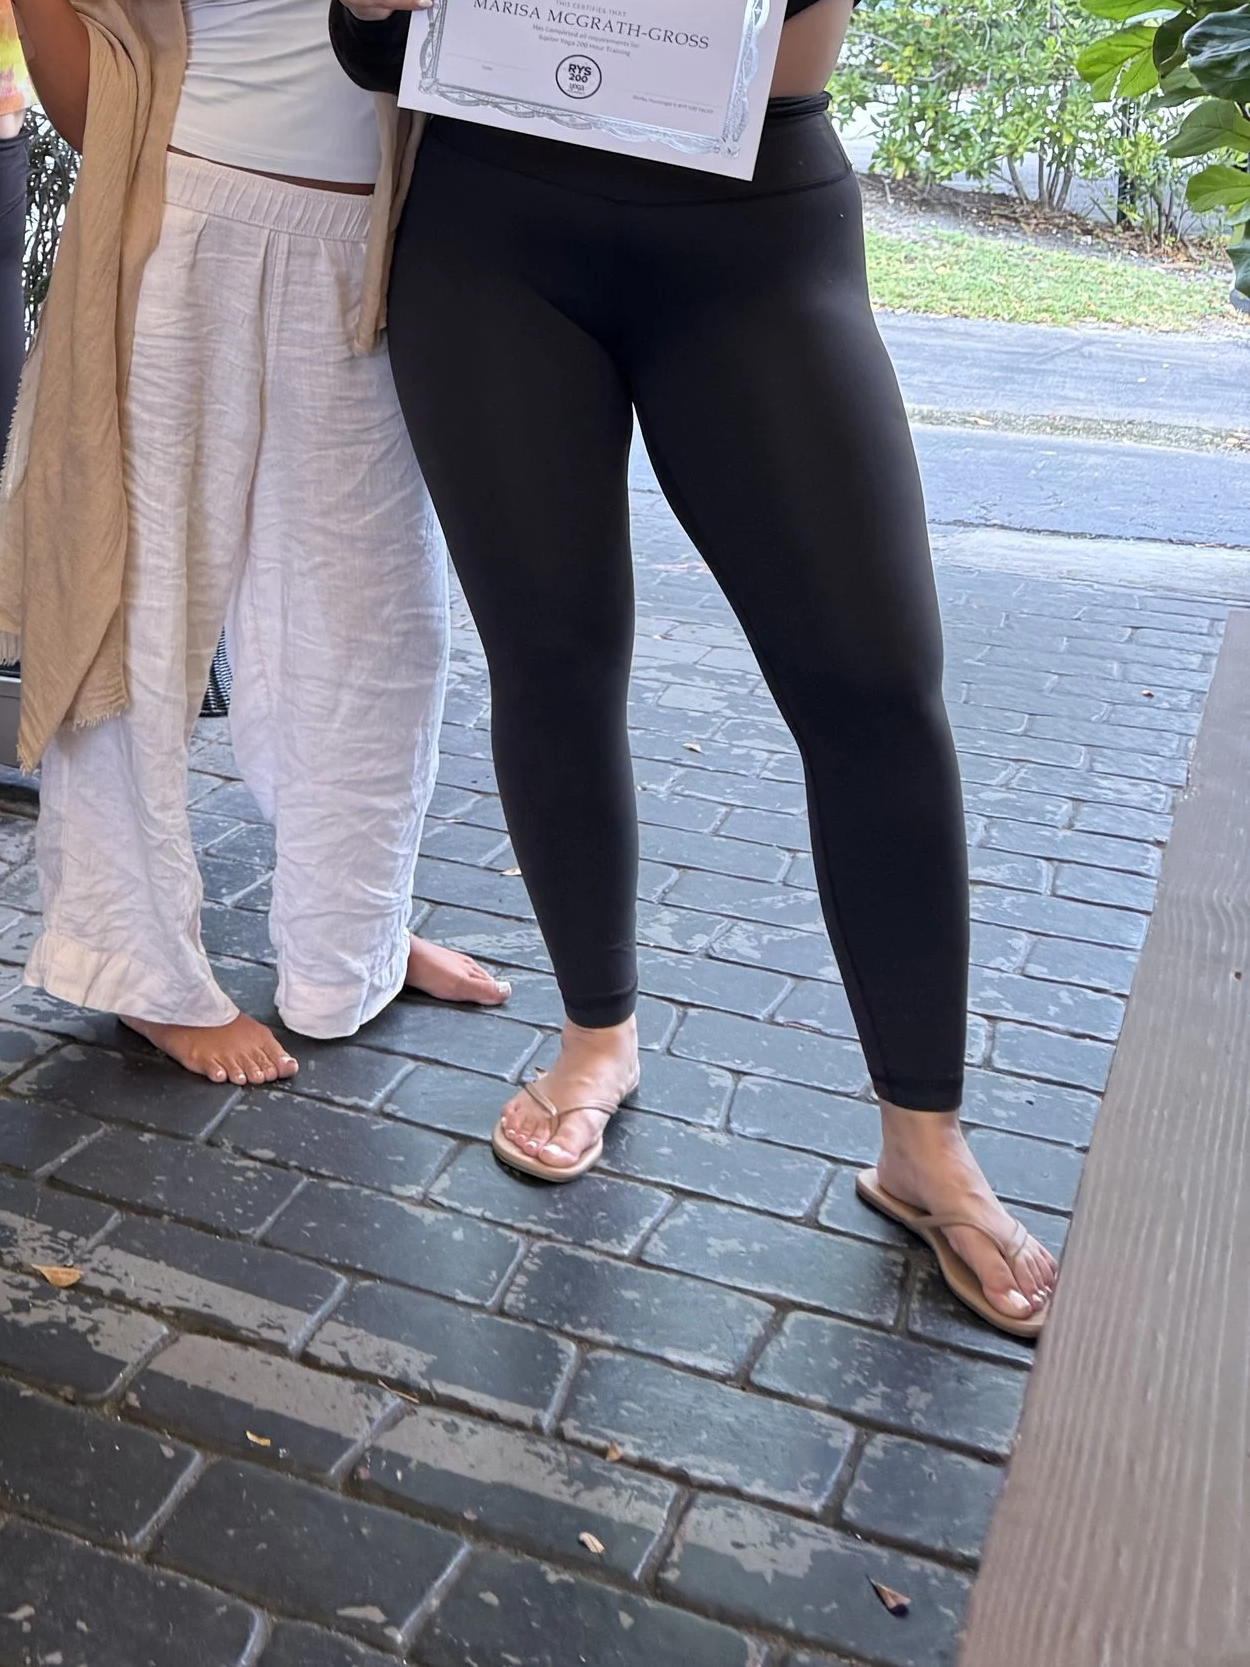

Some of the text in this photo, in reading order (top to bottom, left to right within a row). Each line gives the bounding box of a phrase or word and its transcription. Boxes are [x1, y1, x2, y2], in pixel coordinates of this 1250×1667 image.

[610, 9, 626, 17] THAT
[548, 9, 709, 49] MCGRATH-GROSS
[568, 63, 592, 76] RYS
[569, 73, 588, 83] 200
